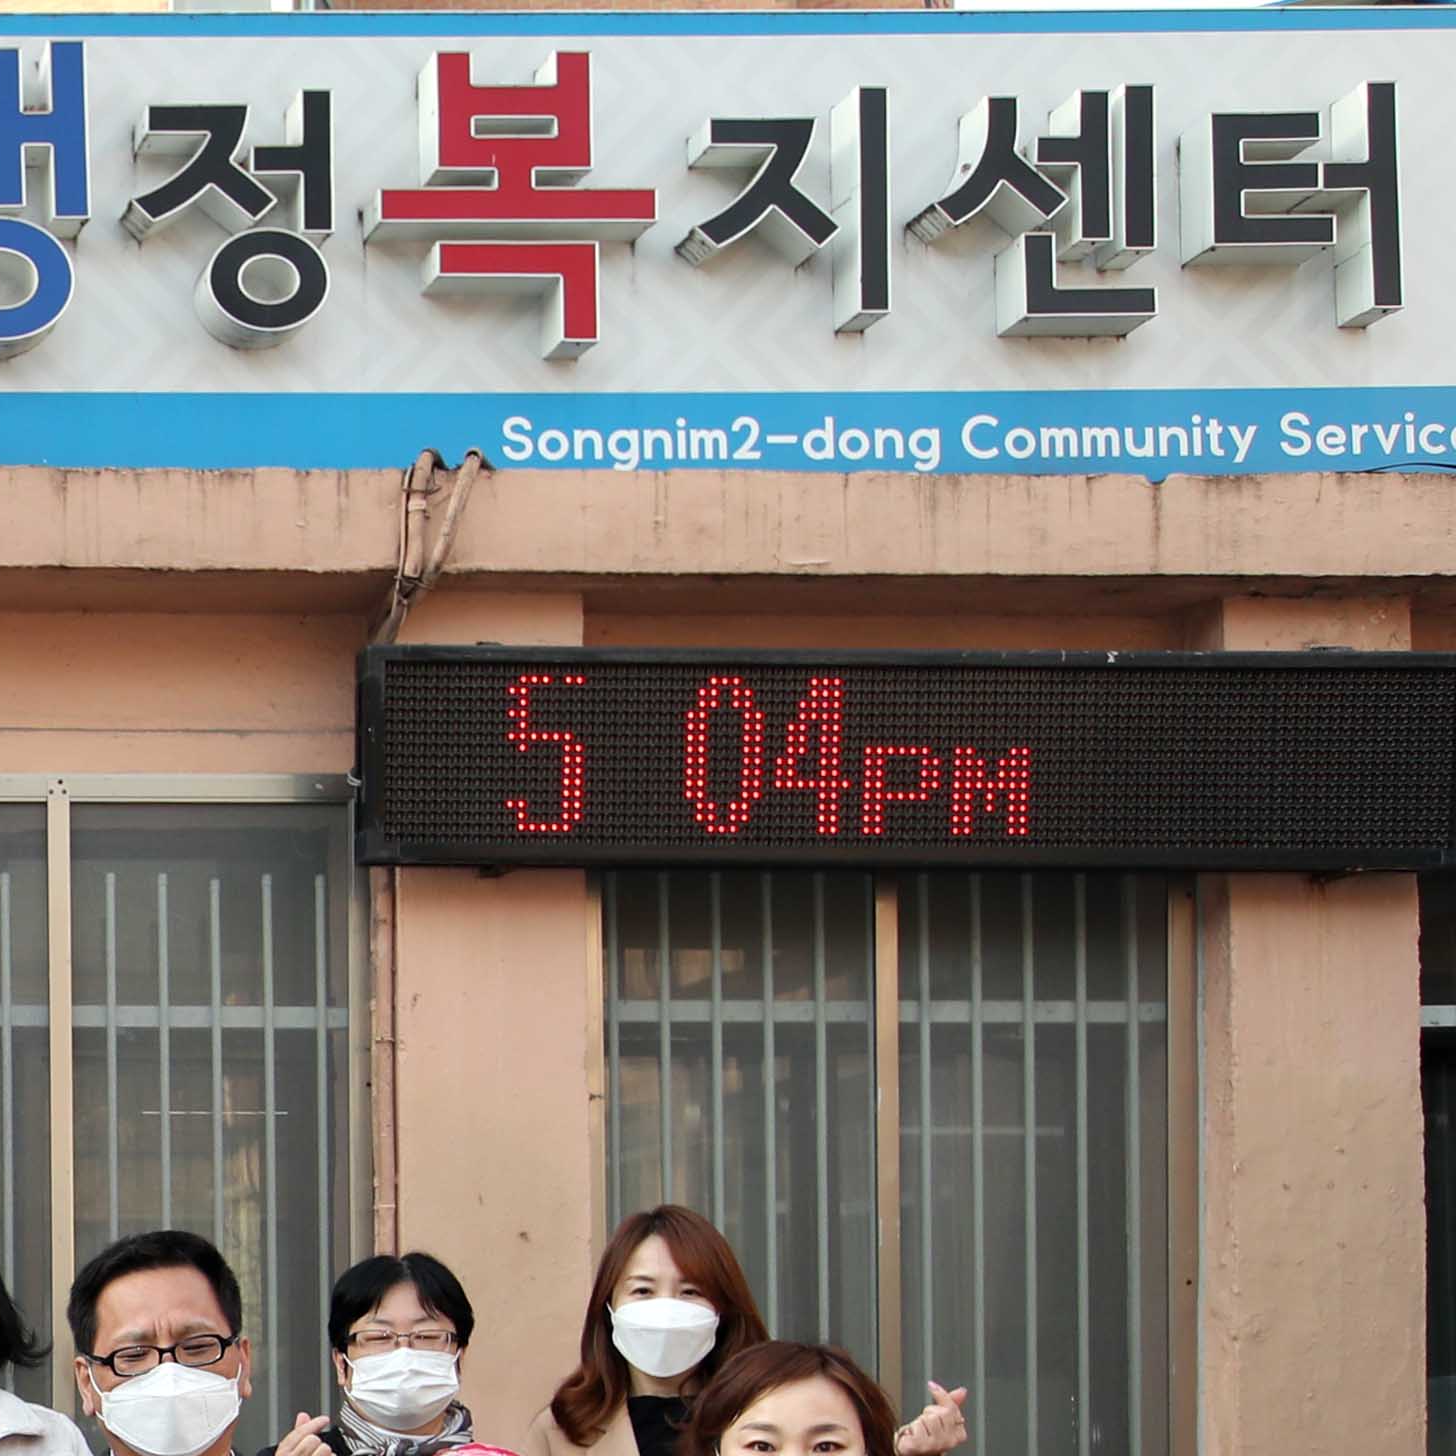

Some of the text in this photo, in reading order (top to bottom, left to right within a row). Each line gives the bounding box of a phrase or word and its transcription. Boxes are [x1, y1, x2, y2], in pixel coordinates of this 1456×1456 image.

[501, 411, 1456, 471] Songnim2-dong Community Servic
